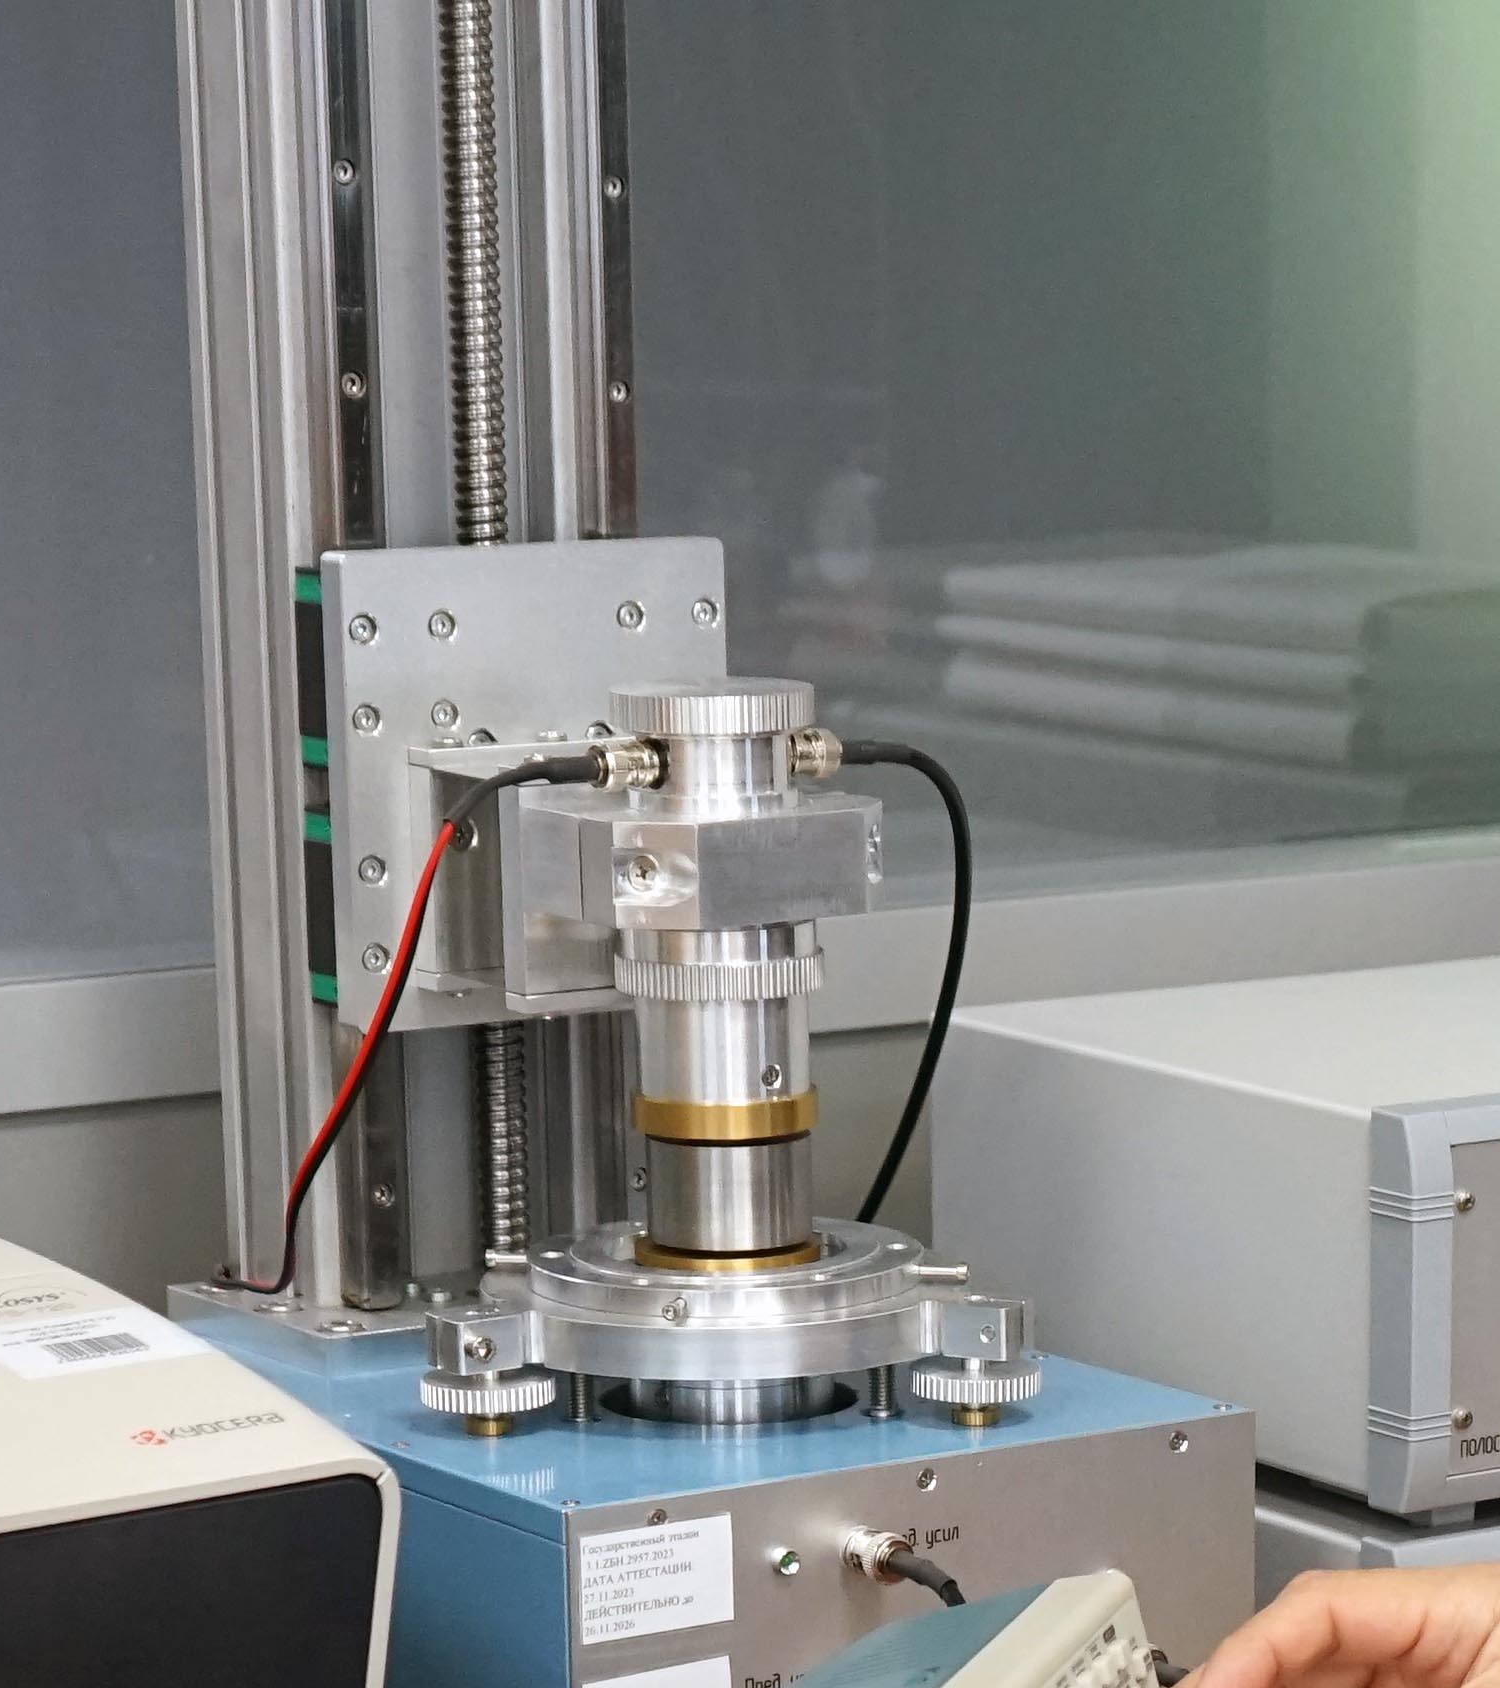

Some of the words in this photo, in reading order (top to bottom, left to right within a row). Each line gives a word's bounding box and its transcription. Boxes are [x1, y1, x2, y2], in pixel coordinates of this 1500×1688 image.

[582, 1534, 665, 1557] Государственный
[925, 1525, 959, 1550] усил
[583, 1576, 614, 1590] ДАТА
[616, 1561, 693, 1584] АТТЕСТАЦИИ
[584, 1595, 681, 1622] ДЕЙСТВИТЕЛЬНО
[584, 1619, 636, 1637] 26.11.2026
